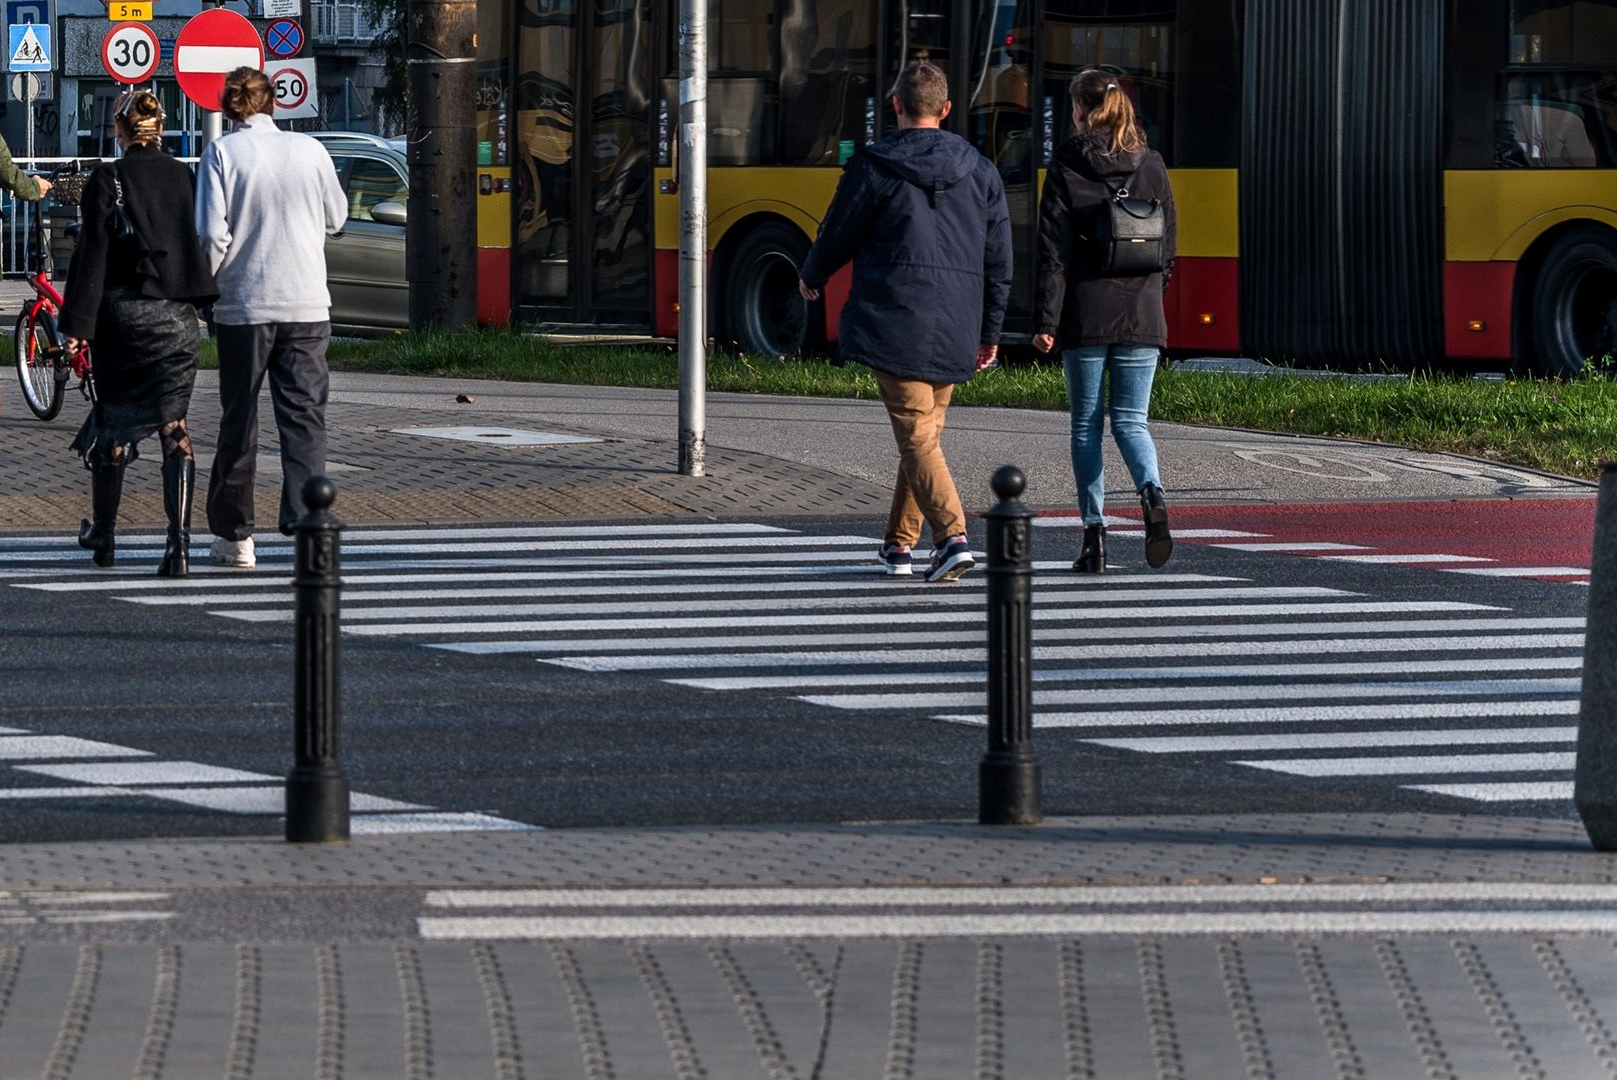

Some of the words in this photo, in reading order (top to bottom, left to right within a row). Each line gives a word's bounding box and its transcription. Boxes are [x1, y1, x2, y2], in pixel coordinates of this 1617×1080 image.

[120, 5, 128, 17] 5
[131, 8, 142, 17] m
[113, 38, 150, 67] 30
[276, 79, 303, 99] 50
